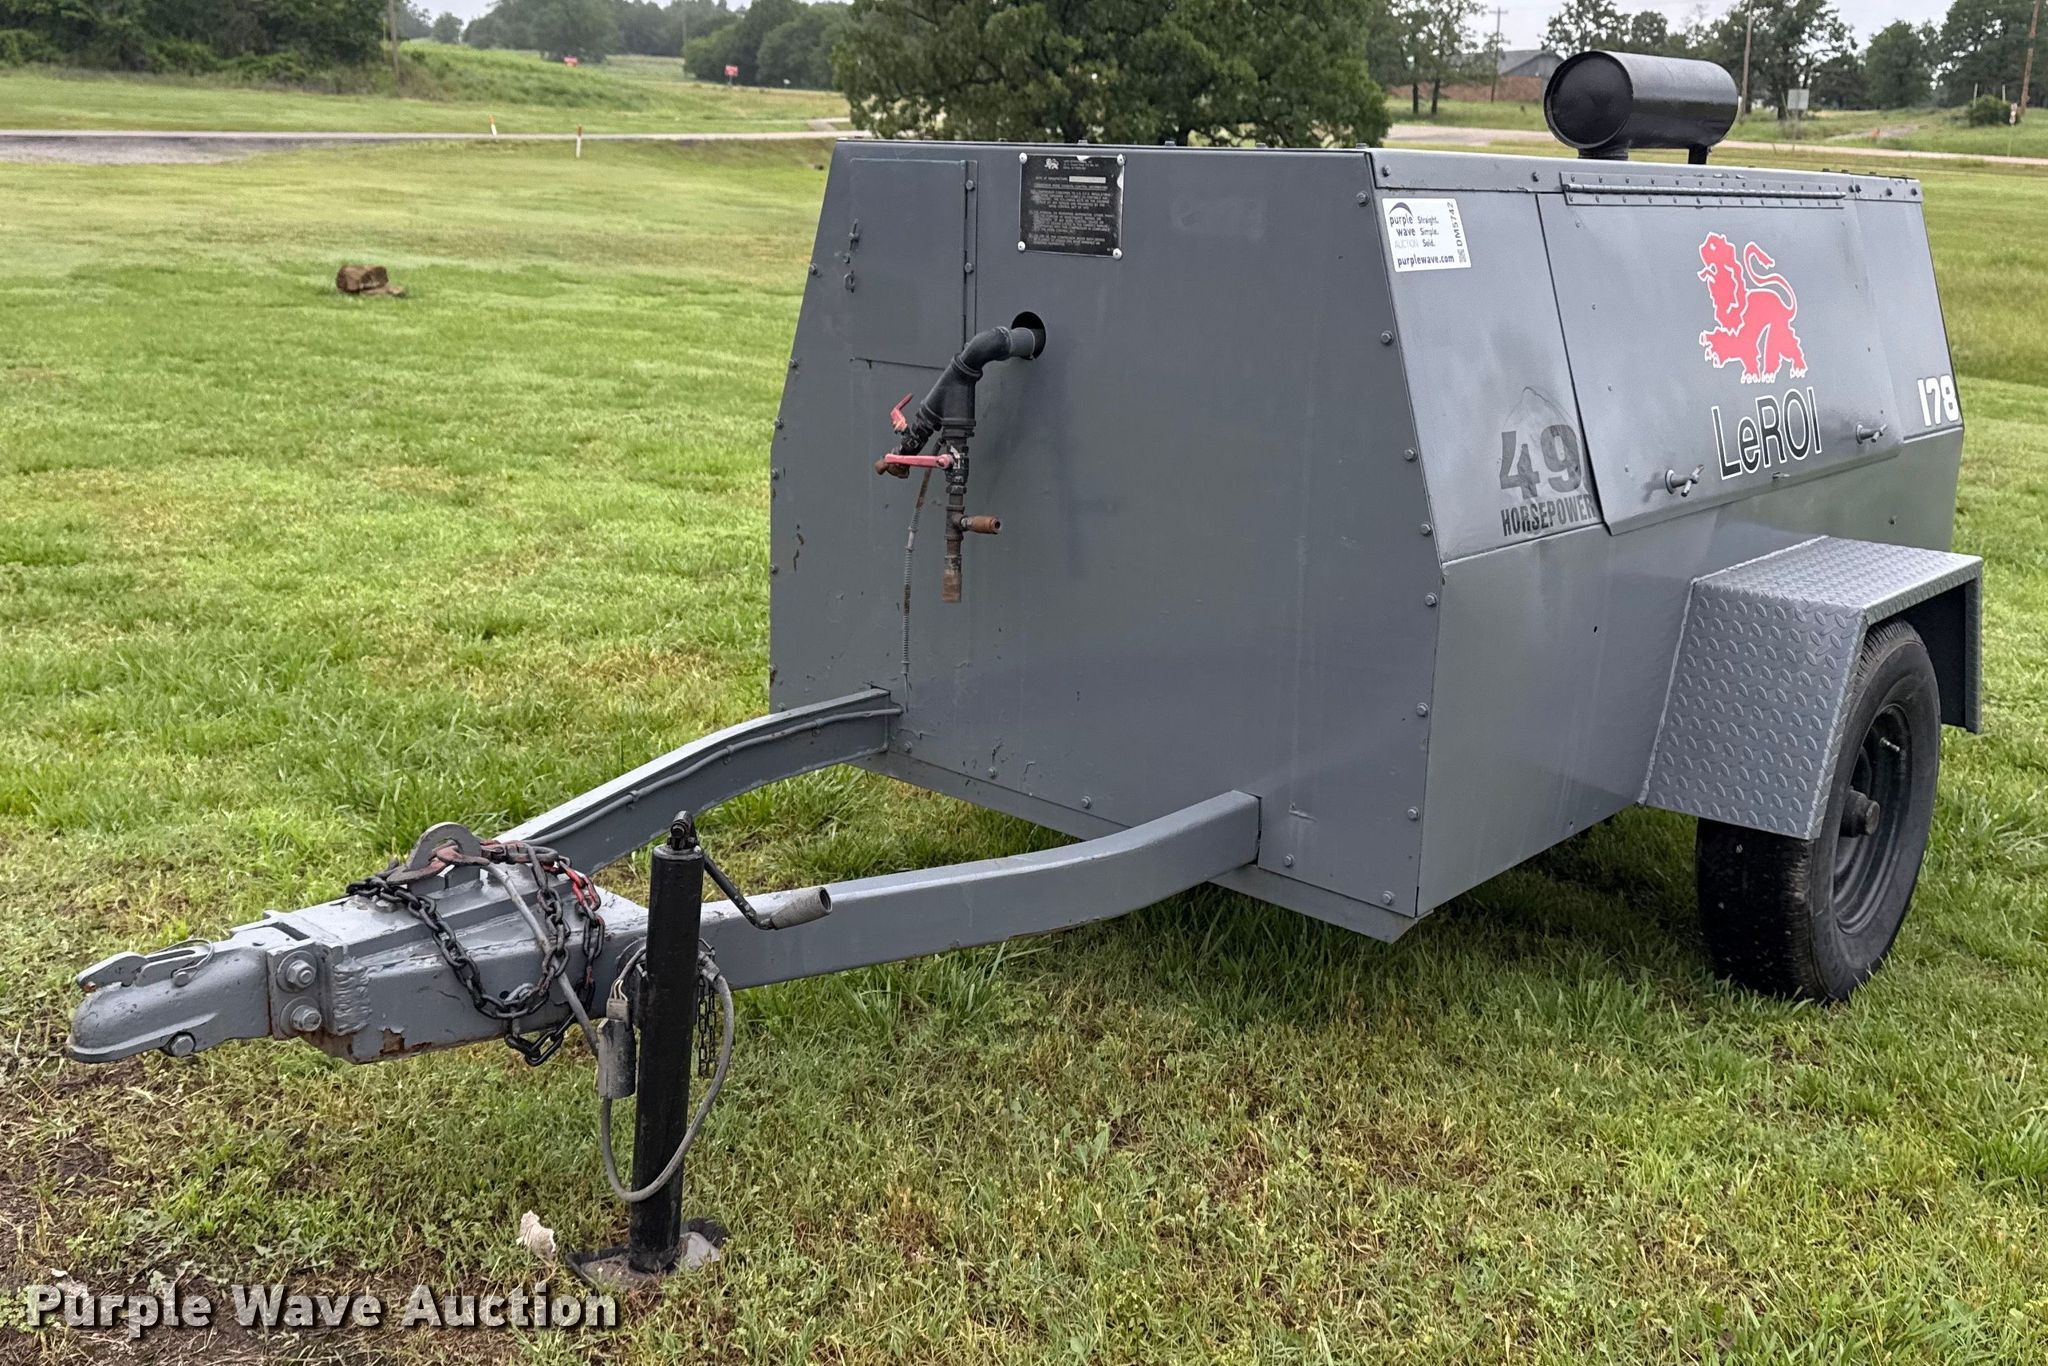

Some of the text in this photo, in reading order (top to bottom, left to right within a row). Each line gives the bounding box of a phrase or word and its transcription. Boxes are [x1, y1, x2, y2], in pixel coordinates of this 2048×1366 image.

[1389, 213, 1413, 227] purple
[1396, 228, 1416, 237] wave
[1447, 201, 1463, 247] DM5742
[1397, 254, 1454, 268] purplewave.com
[1917, 375, 1960, 427] 178
[1711, 386, 1822, 480] LeROI
[1499, 424, 1582, 499] 49
[1500, 494, 1597, 536] HORSEPOWER
